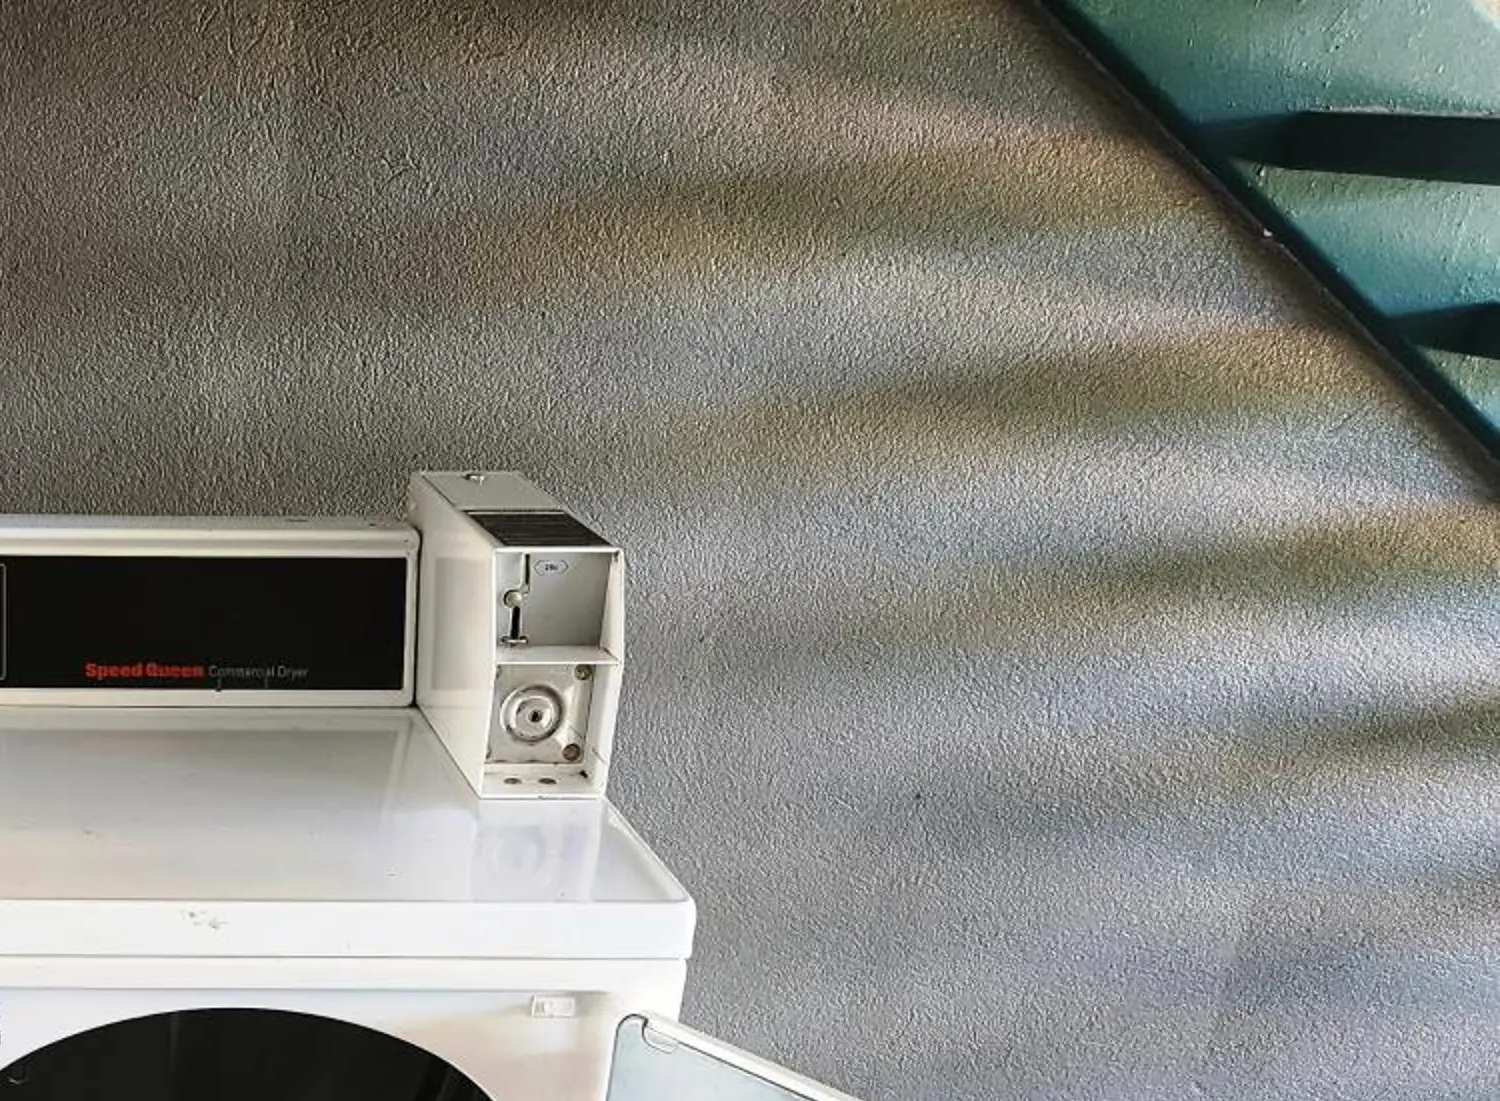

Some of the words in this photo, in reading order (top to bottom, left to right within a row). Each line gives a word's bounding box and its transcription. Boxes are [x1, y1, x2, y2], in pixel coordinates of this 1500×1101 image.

[85, 663, 142, 680] Speed
[146, 663, 204, 678] Queen
[209, 665, 275, 678] Commercial
[277, 665, 309, 681] Dryer
